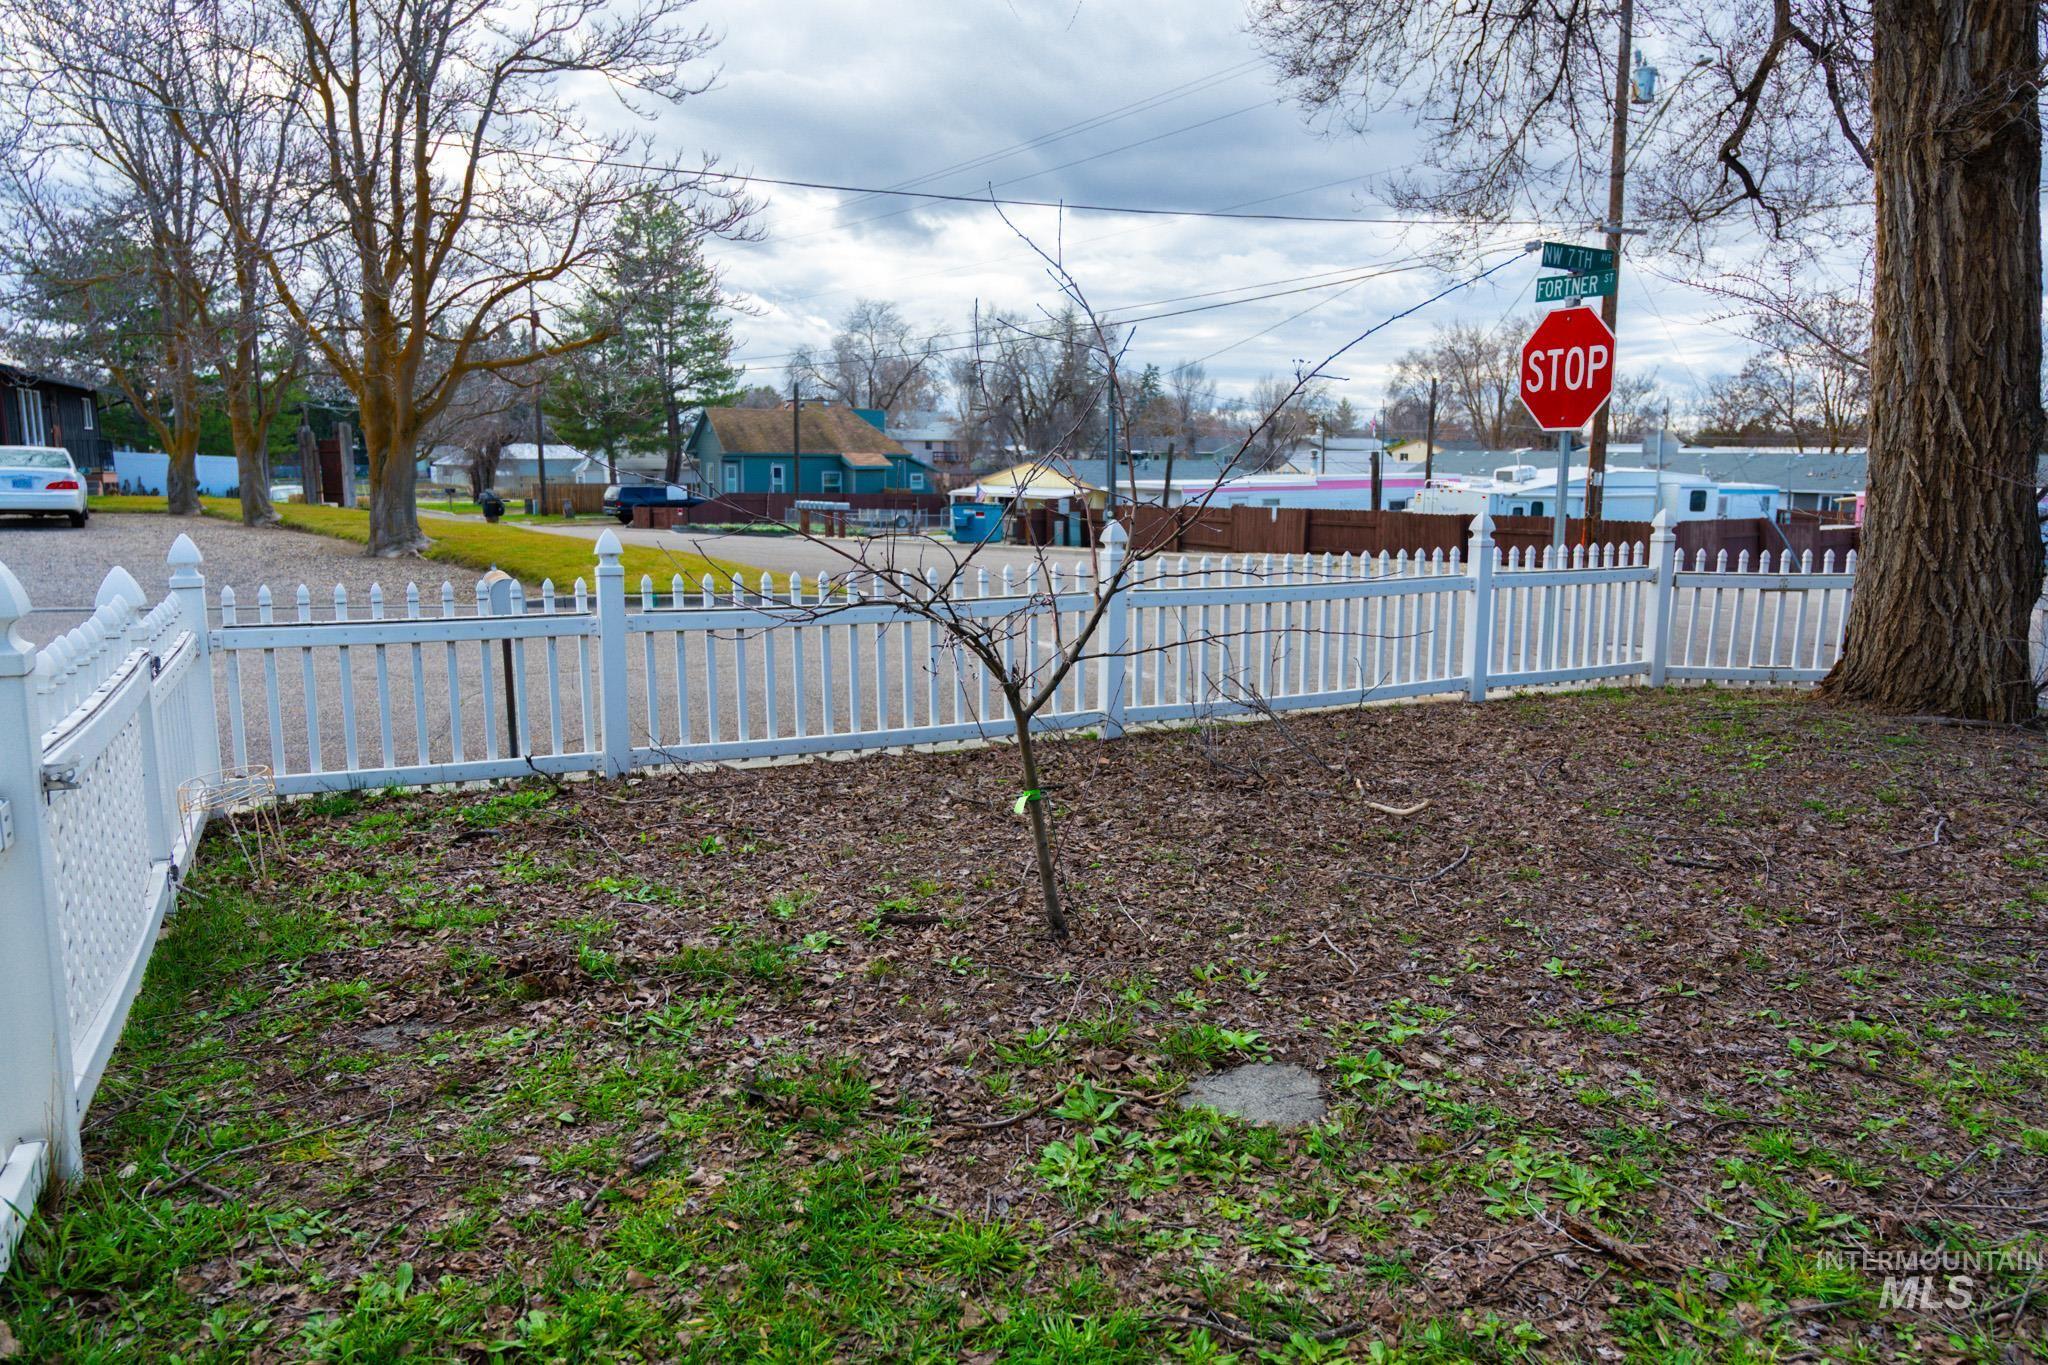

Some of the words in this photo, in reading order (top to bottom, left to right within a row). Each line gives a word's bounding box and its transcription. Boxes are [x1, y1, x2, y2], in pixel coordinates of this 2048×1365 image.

[1544, 245, 1563, 265] NW
[1568, 248, 1593, 269] 7TH
[1600, 253, 1612, 264] AVE
[1537, 275, 1598, 298] FORTNER
[1603, 272, 1615, 283] ST
[1526, 345, 1609, 393] STOP
